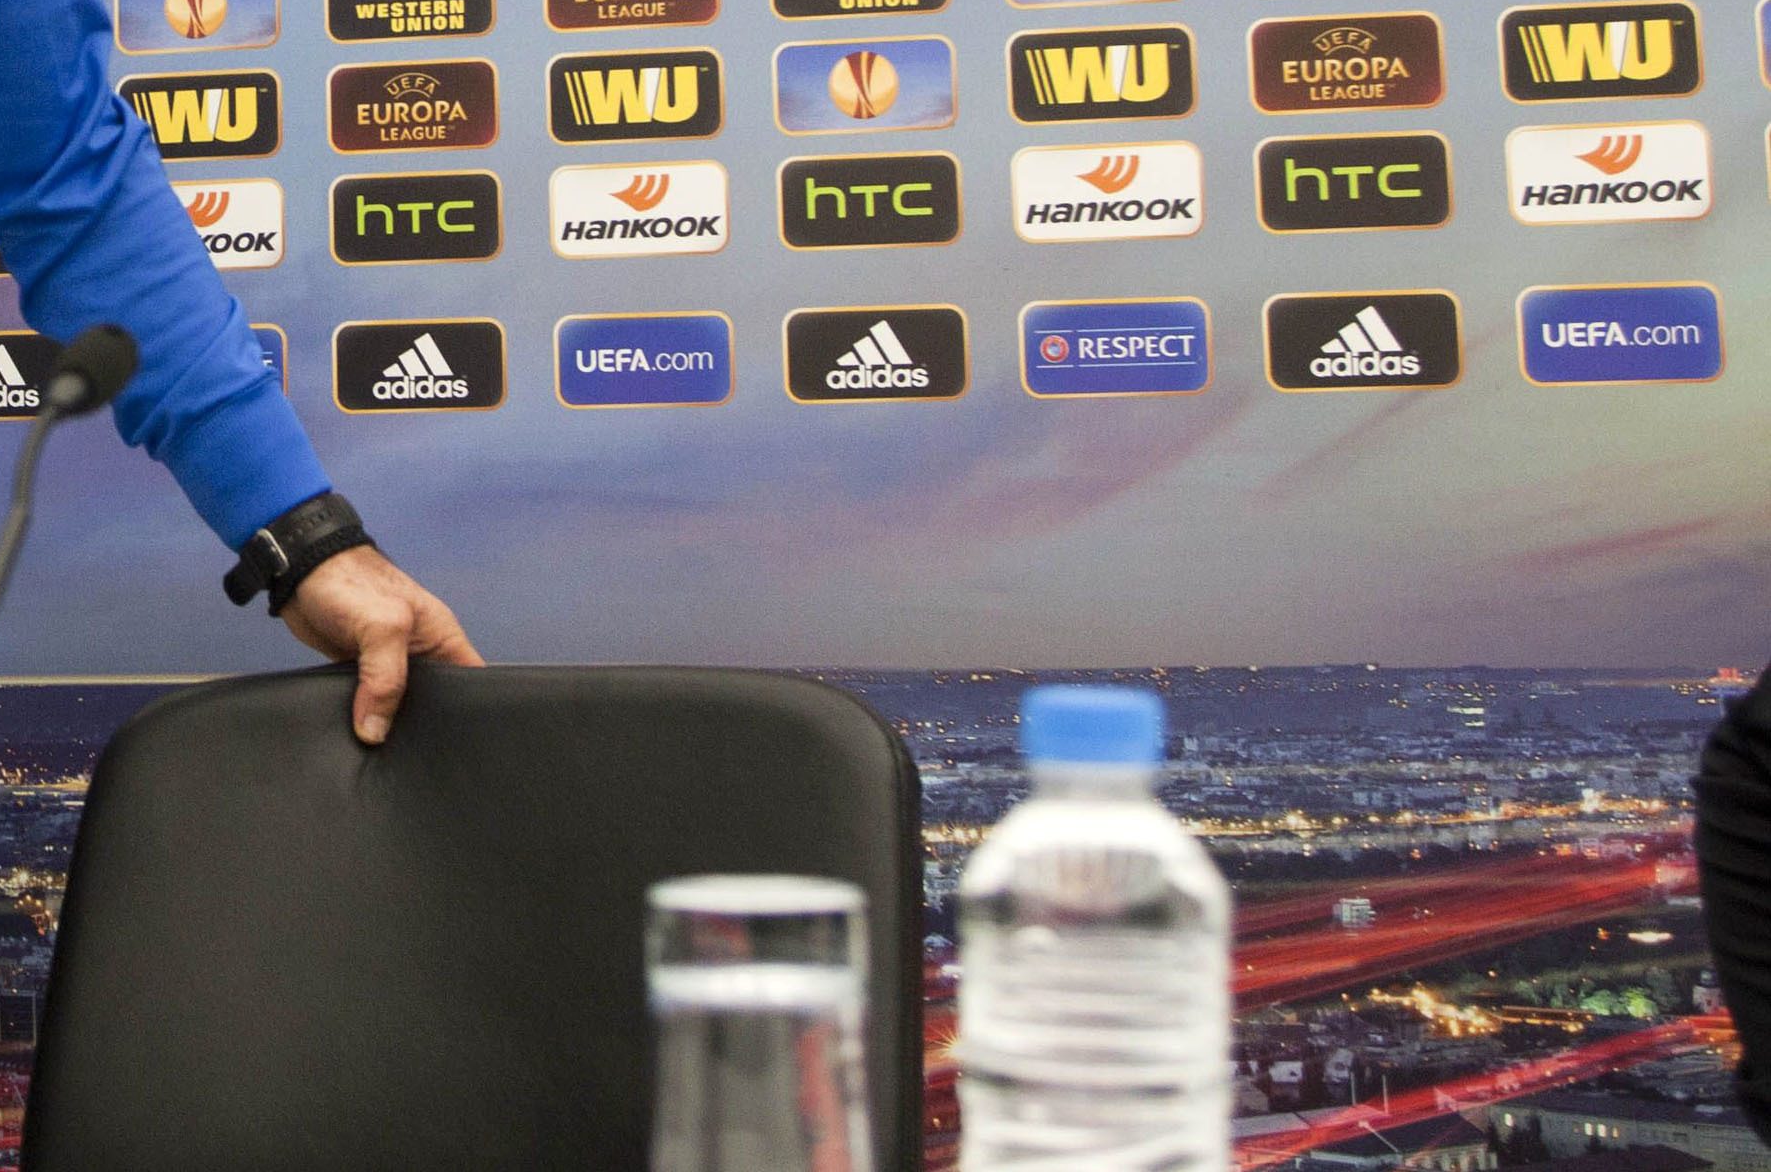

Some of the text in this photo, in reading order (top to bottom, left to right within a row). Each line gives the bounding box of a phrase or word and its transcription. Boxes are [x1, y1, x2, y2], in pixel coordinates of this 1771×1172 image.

[355, 0, 464, 19] WESTERN
[598, 1, 666, 20] LEAGUE
[390, 14, 464, 32] UNION
[1313, 31, 1373, 53] UEFA
[1538, 19, 1672, 81] WU
[1044, 43, 1169, 105] WU
[1282, 57, 1410, 83] EUROPA
[386, 76, 436, 95] UEFA
[582, 65, 698, 125] WU
[1309, 83, 1385, 101] LEAGUE
[149, 87, 257, 144] WU
[356, 99, 467, 125] EUROPA
[380, 125, 446, 141] LEAGUE
[1078, 334, 1195, 360] RESPECT
[1541, 322, 1700, 348] UEFA.com
[575, 348, 713, 373] UEFA.com
[1309, 350, 1420, 378] adidas
[372, 374, 468, 400] adidas
[826, 363, 929, 389] adidas
